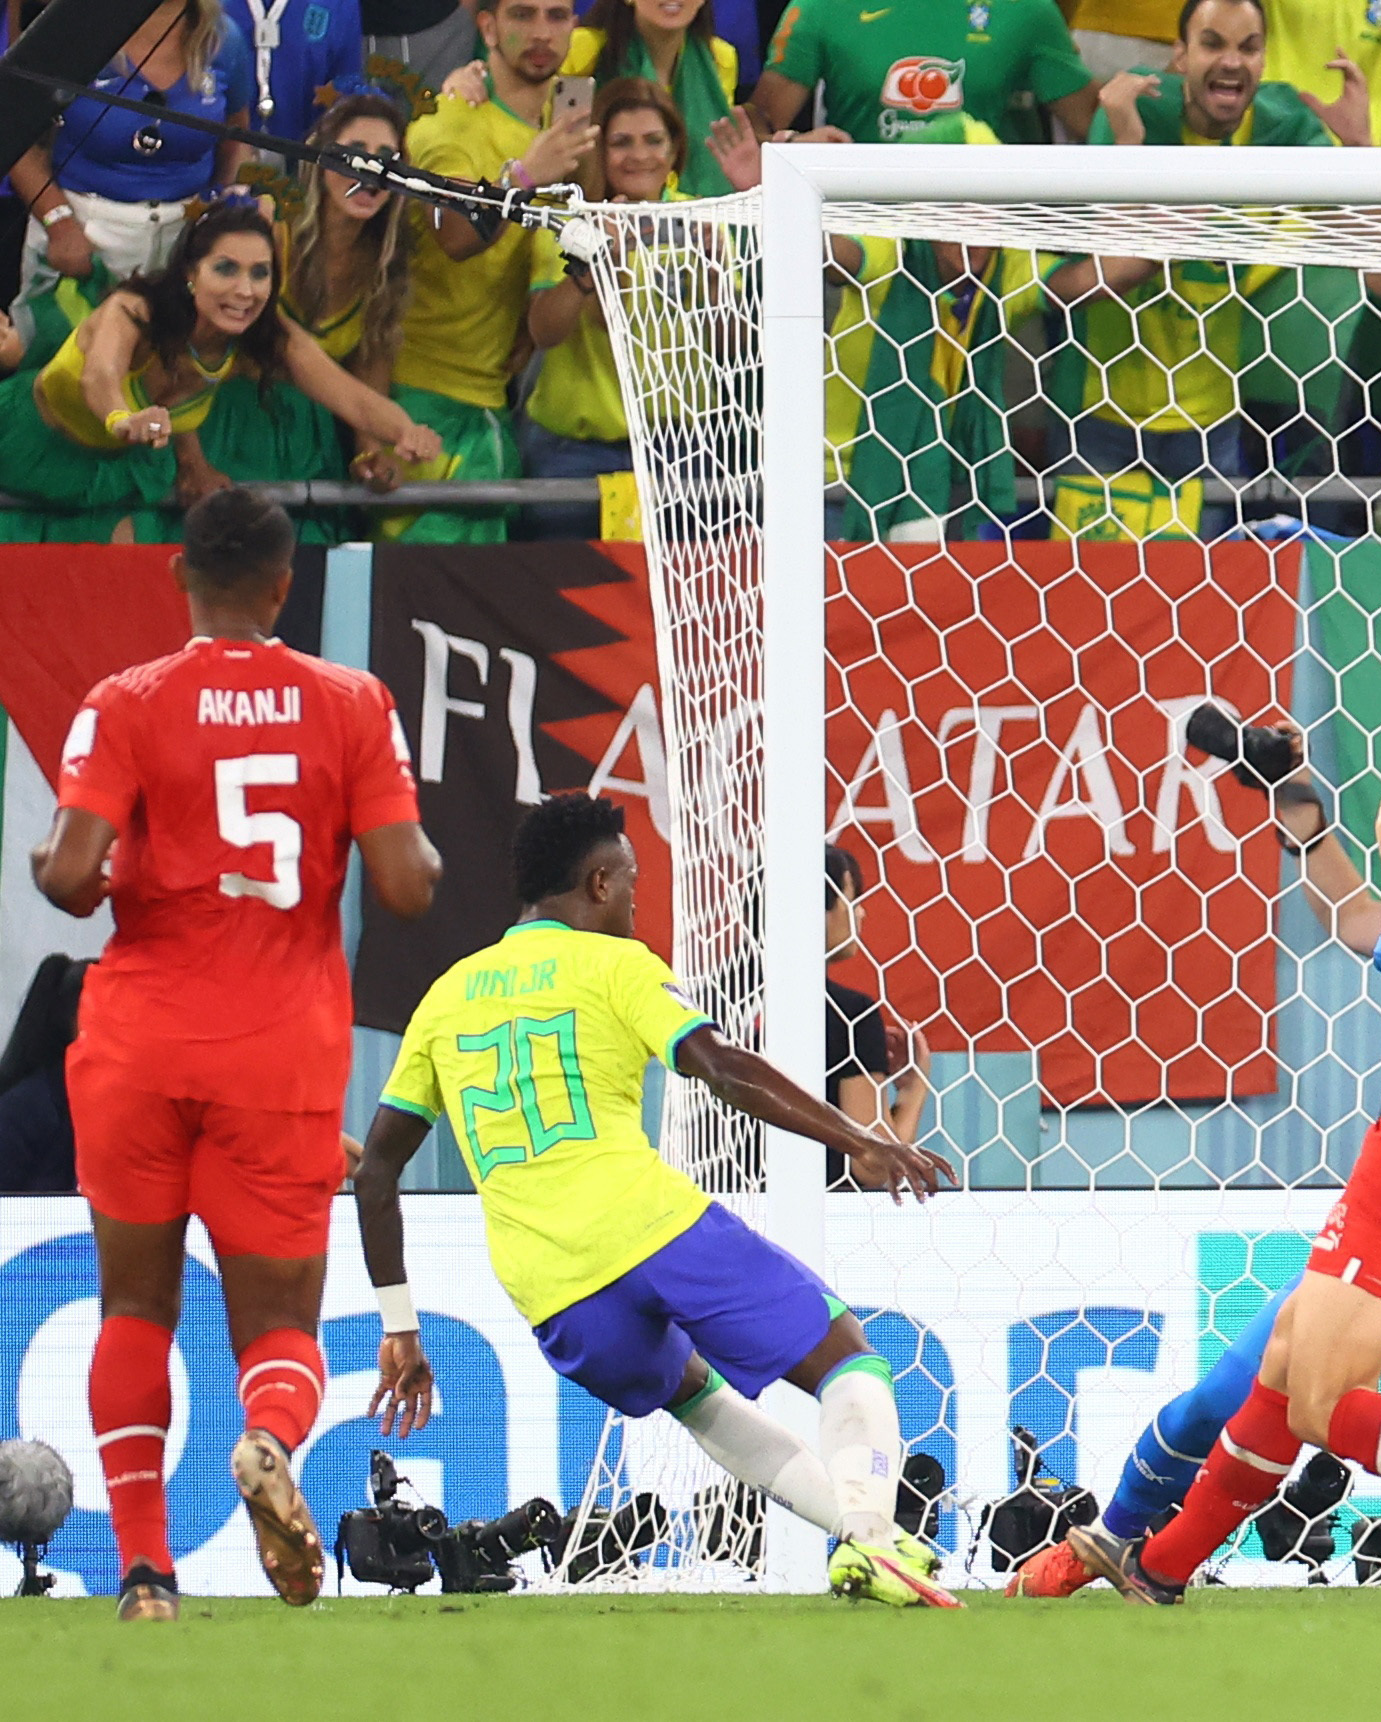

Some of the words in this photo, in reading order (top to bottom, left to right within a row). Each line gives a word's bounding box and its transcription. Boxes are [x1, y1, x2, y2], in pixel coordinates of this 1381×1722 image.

[198, 686, 300, 727] AKANJI
[215, 753, 301, 910] 5
[466, 966, 517, 1001] VINI
[520, 958, 557, 994] JR
[456, 1008, 597, 1184] 20
